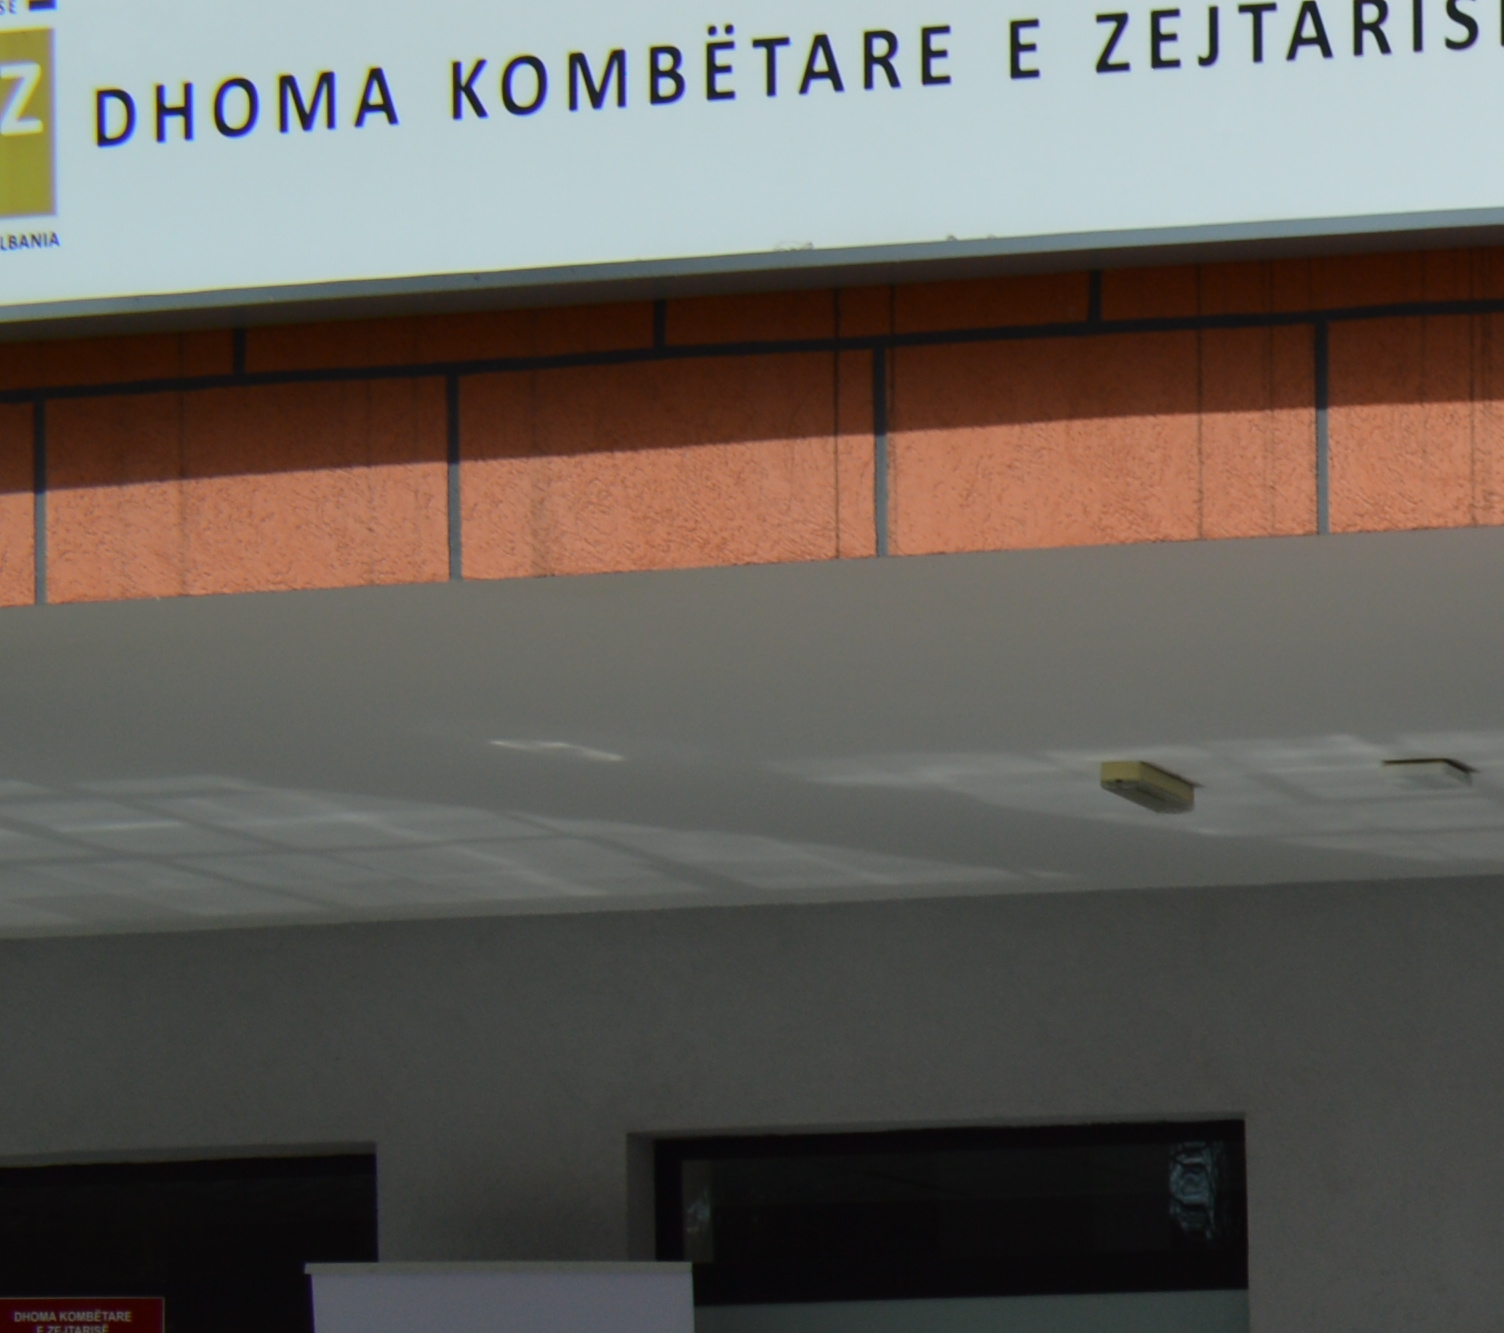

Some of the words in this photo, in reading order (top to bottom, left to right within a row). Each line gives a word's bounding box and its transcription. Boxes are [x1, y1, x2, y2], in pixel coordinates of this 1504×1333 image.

[96, 69, 400, 150] DHOMA
[448, 23, 955, 121] KOMBËTARE
[1008, 16, 1042, 78] E
[13, 1311, 57, 1323] DHOMA
[59, 1309, 133, 1322] KOMBËTARE
